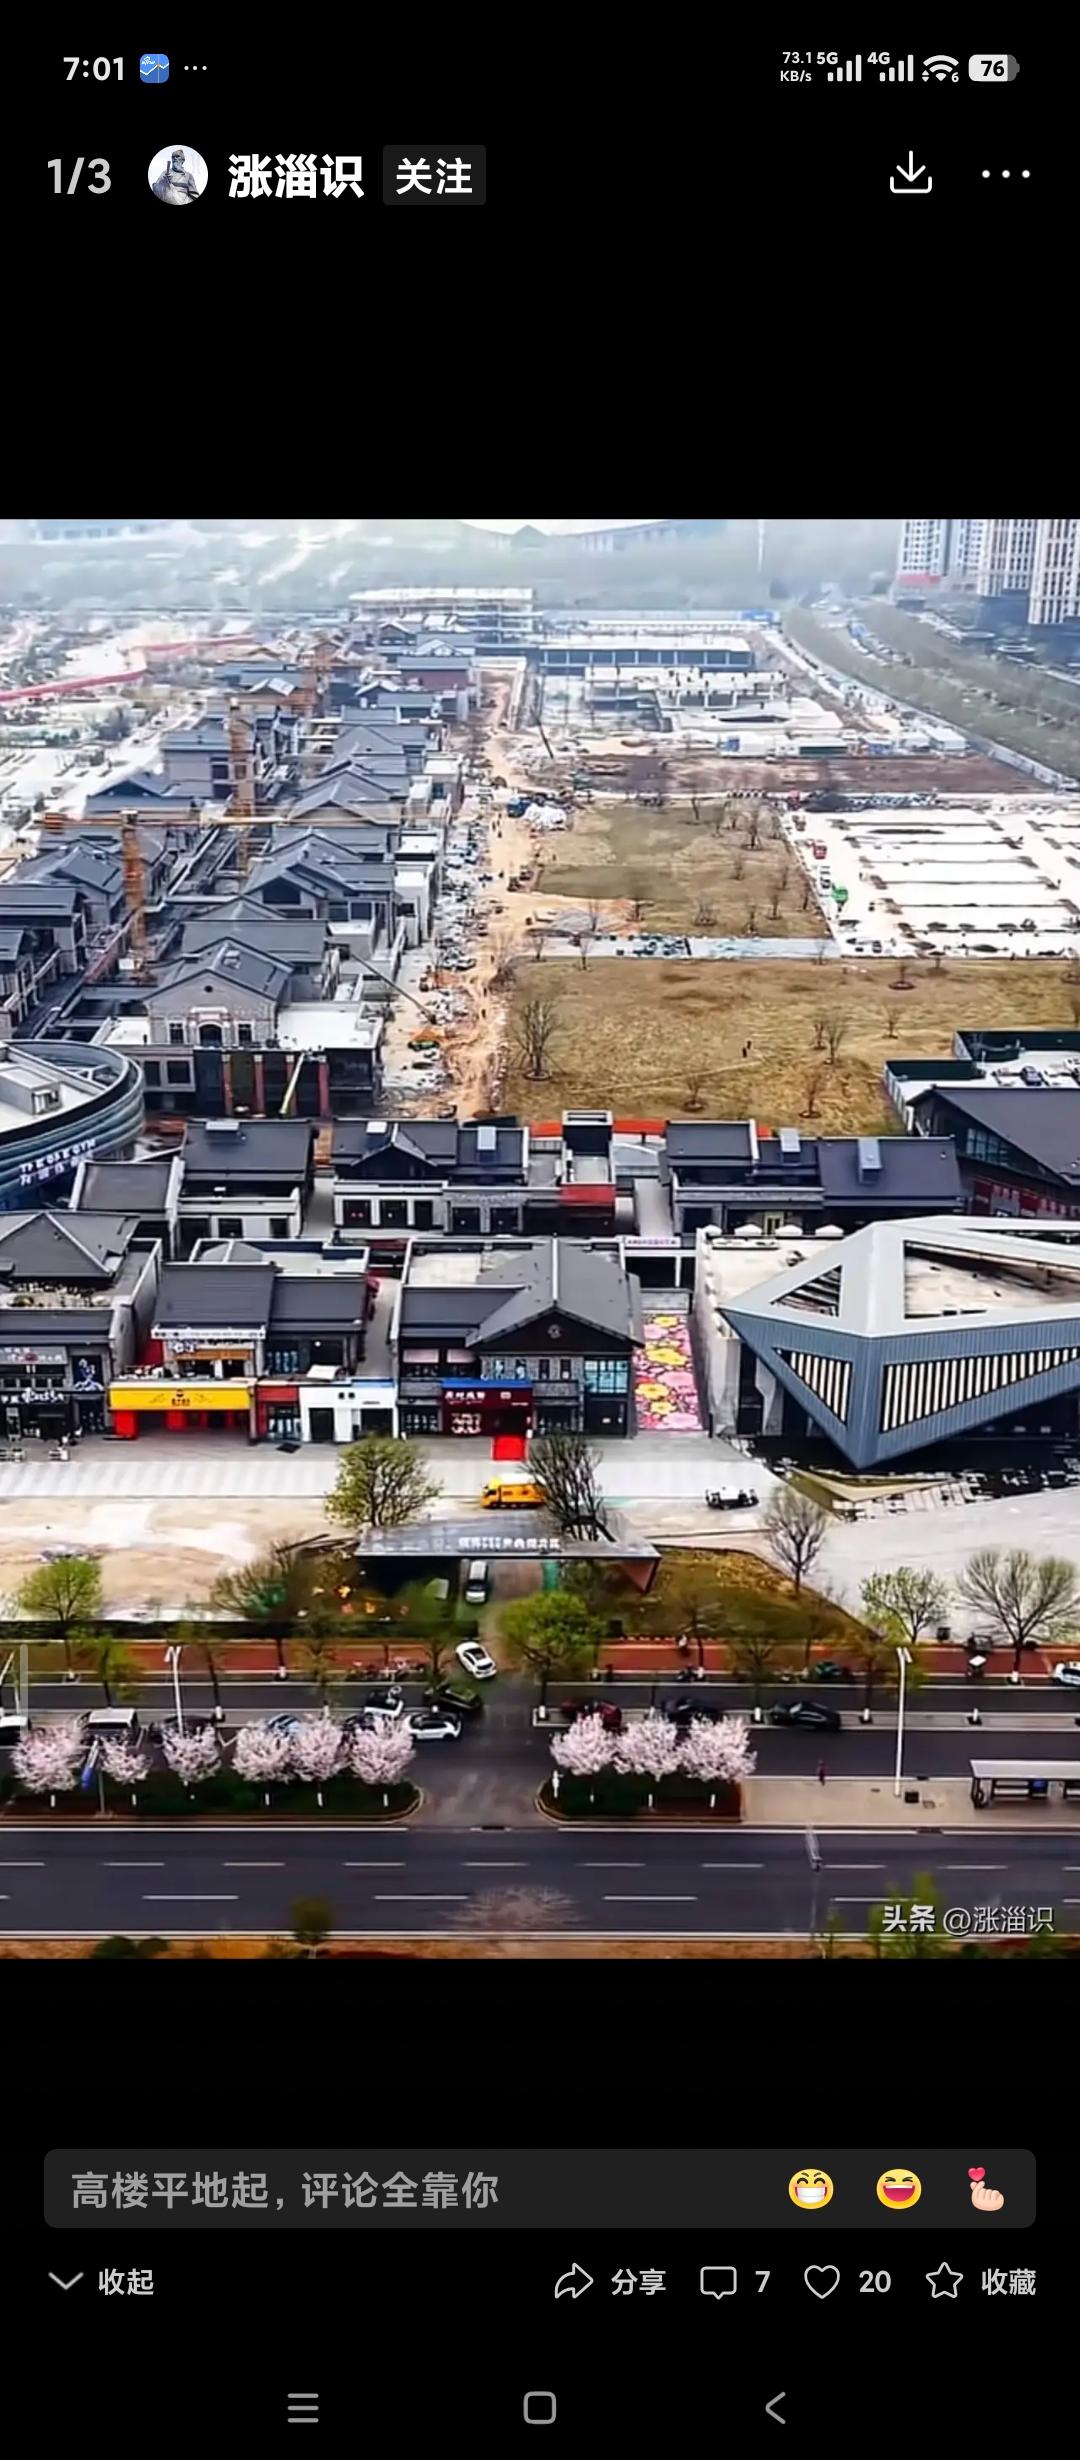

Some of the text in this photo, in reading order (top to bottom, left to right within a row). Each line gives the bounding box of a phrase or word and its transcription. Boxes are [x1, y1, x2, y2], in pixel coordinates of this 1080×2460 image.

[63, 56, 124, 81] 7:01
[782, 51, 812, 64] 73.1
[816, 51, 839, 65] 5G
[866, 51, 891, 65] 4G
[980, 60, 1005, 77] 76
[780, 69, 812, 83] KB/s
[951, 72, 960, 83] 6
[47, 157, 112, 195] 1/3
[227, 153, 365, 199] 涨淄识
[395, 157, 473, 195] 关注
[98, 2268, 154, 2296] 收起
[610, 2268, 666, 2296] 分享
[755, 2270, 771, 2293] 7
[858, 2270, 892, 2293] 20
[981, 2268, 1037, 2296] 收藏
